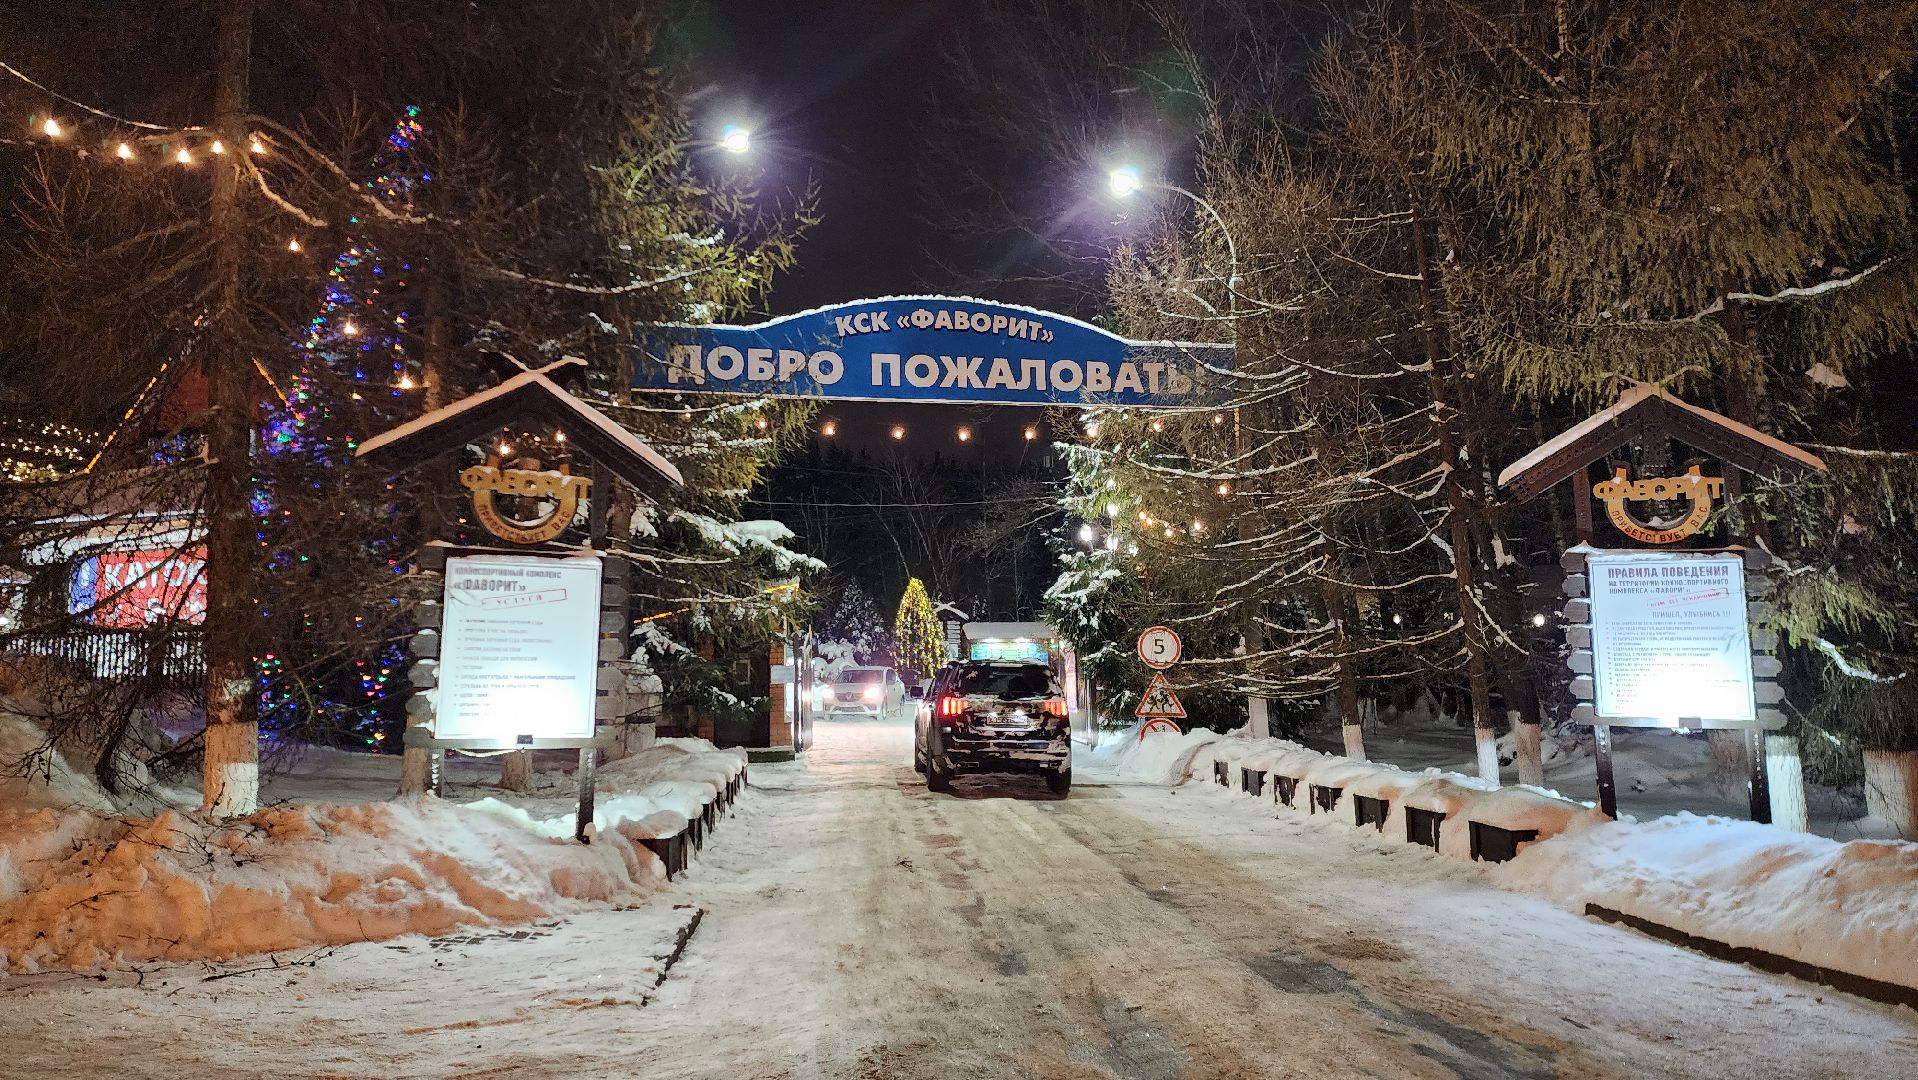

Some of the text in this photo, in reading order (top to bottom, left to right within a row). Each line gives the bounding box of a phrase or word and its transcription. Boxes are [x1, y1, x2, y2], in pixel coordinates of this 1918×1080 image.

[835, 308, 1055, 343] КСК «ФАВОРИТ»
[667, 344, 845, 385] ДОБРО
[1593, 477, 1725, 501] ФАВОРИТ
[1690, 506, 1708, 528] ВАС
[104, 559, 208, 591] КАТОК
[1608, 565, 1729, 579] ПРАВИЛА ПОВЕДЕНИЯ
[453, 578, 526, 592] «ФАВОРИТ»
[1153, 638, 1165, 655] 5
